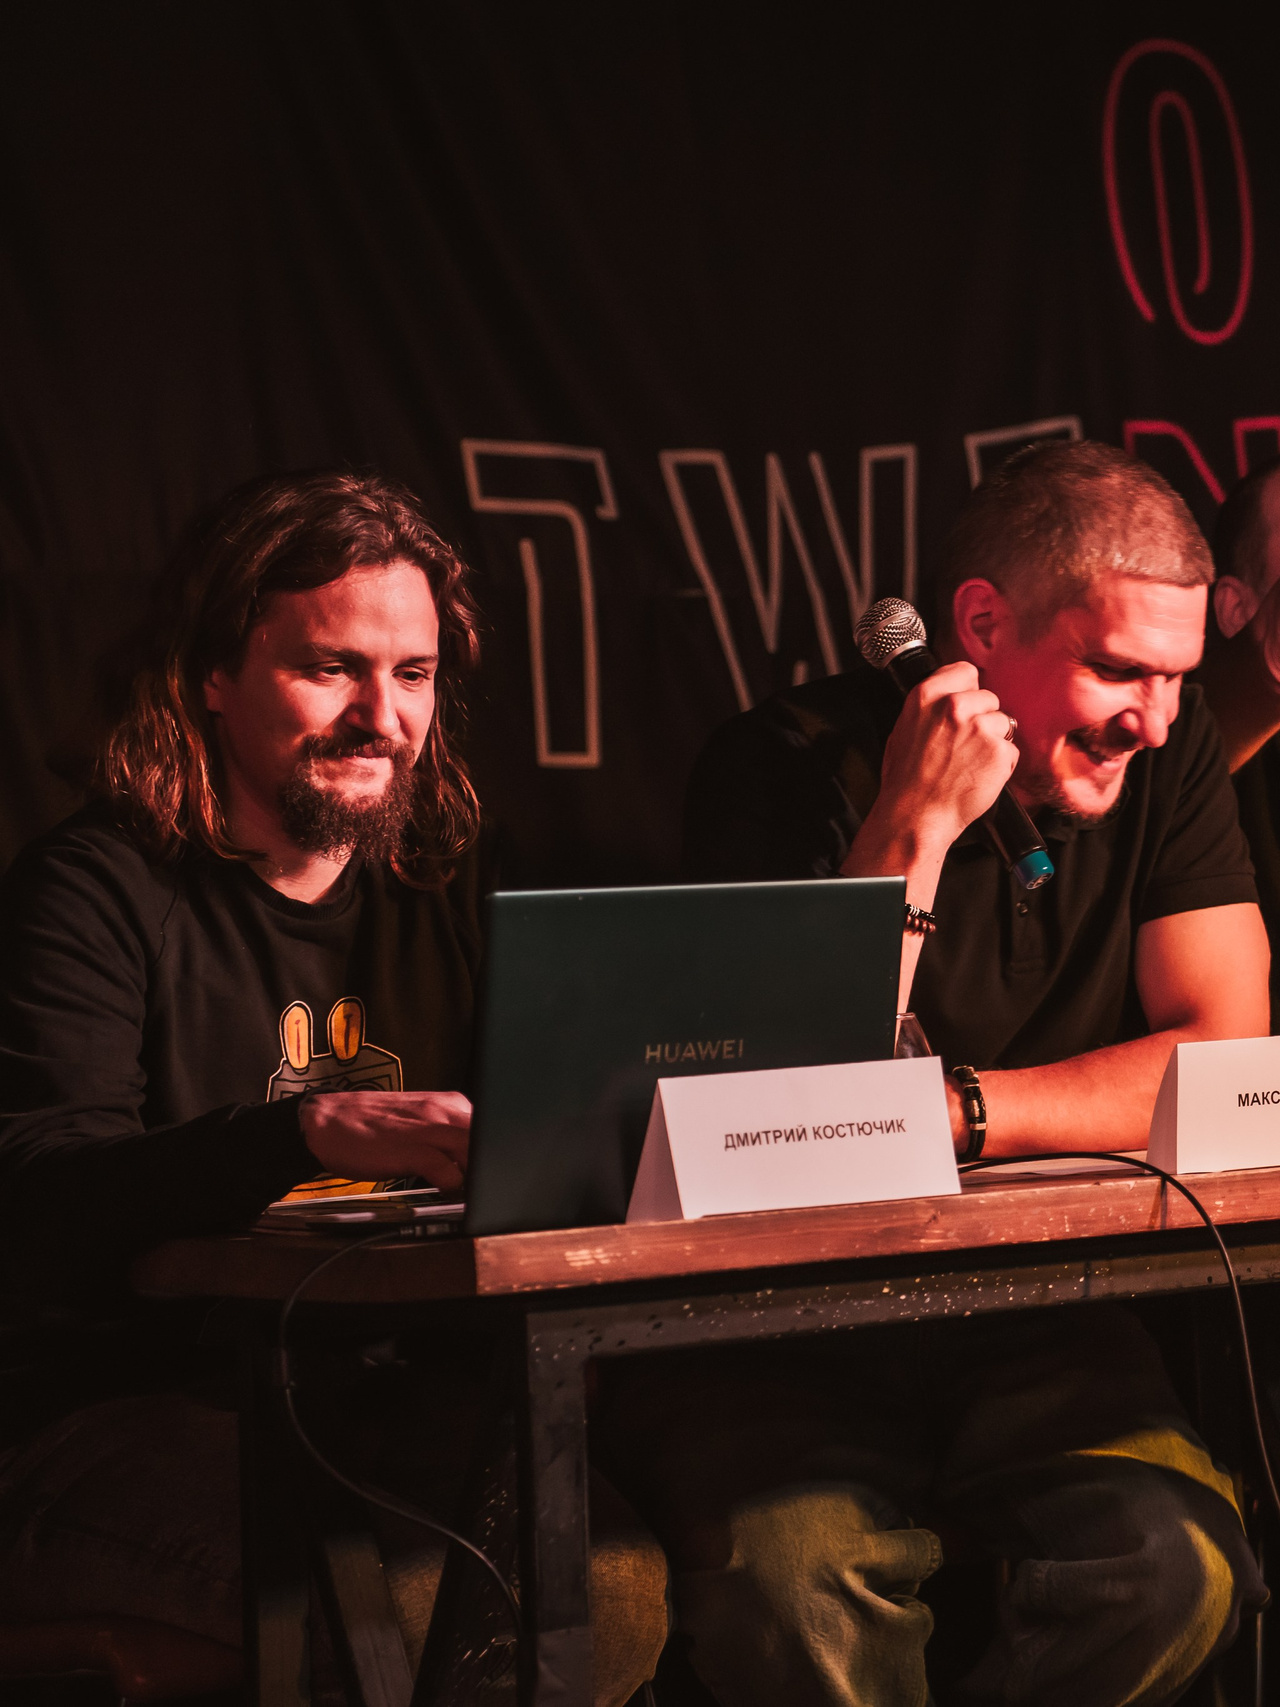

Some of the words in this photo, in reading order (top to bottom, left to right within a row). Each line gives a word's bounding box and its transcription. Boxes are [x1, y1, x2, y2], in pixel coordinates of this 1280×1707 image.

[644, 1039, 744, 1064] HUAWEI
[724, 1124, 808, 1151] ДМИТРИЙ
[812, 1118, 907, 1140] КОСТЮЧИК
